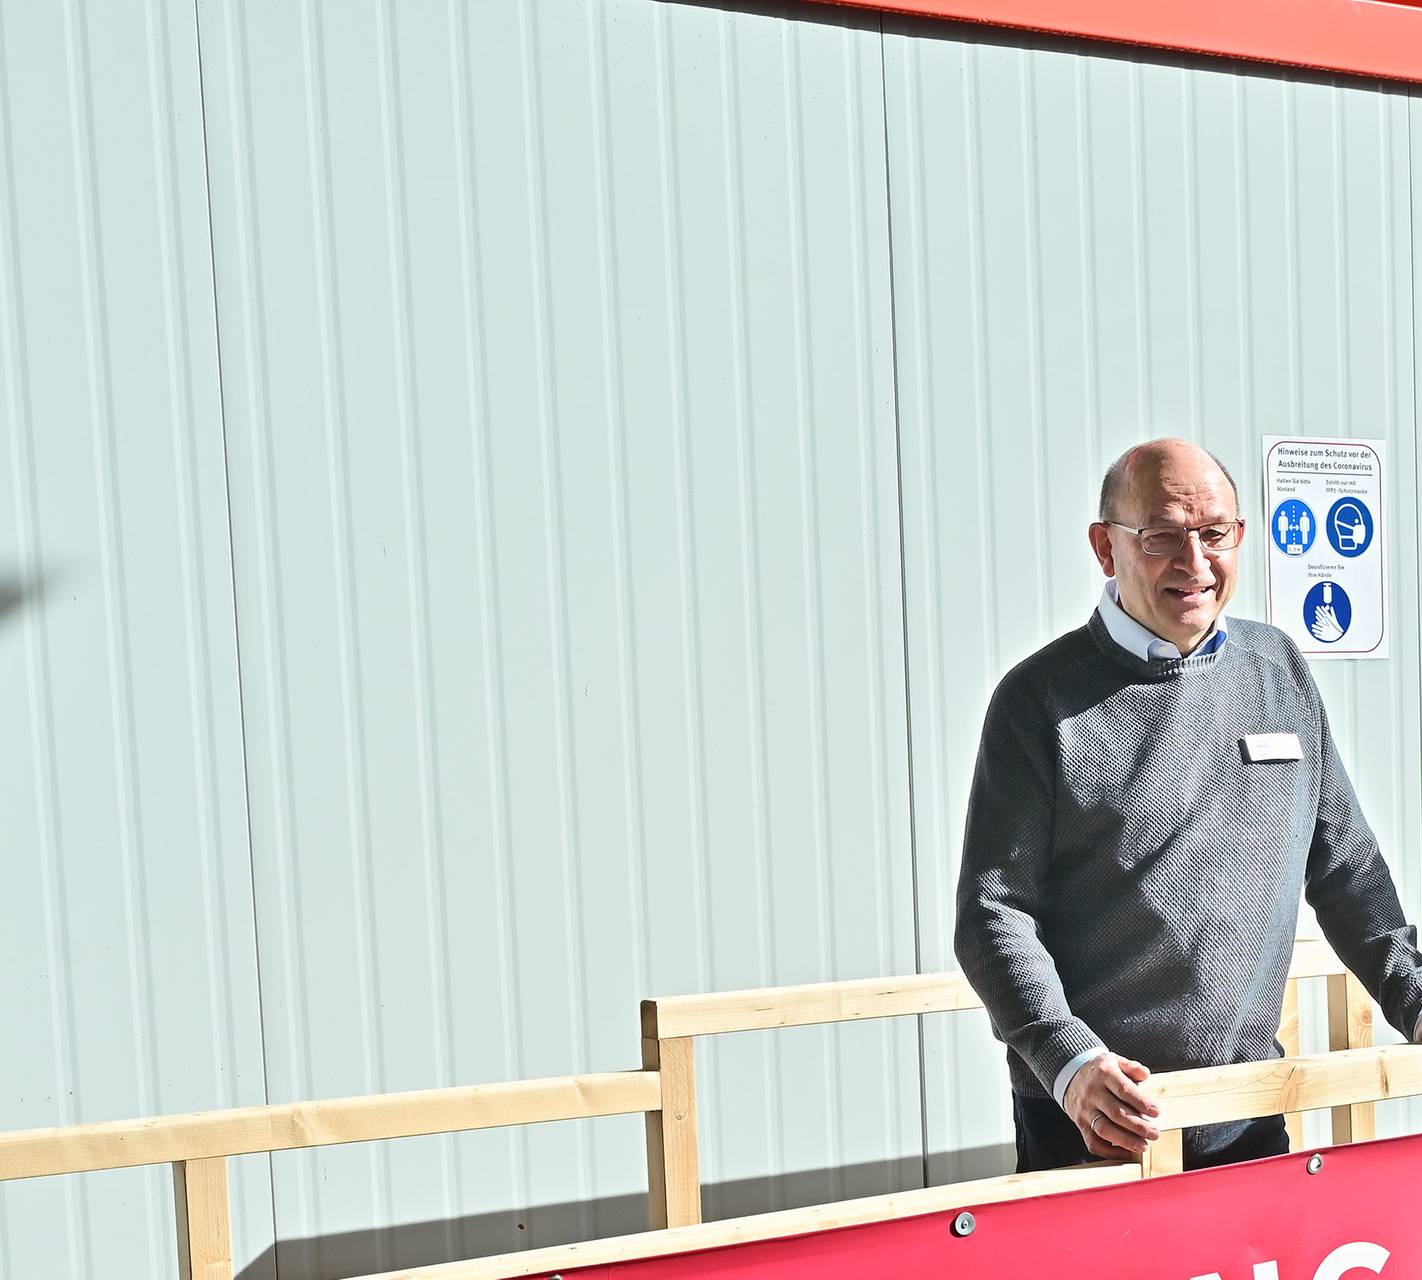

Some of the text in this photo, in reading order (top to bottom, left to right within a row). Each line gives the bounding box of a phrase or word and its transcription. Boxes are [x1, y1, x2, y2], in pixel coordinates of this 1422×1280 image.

[1278, 448, 1308, 456] Hinweise
[1325, 449, 1347, 458] Schutz
[1278, 460, 1318, 470] Ausbreitung
[1333, 462, 1372, 470] Coronavirus
